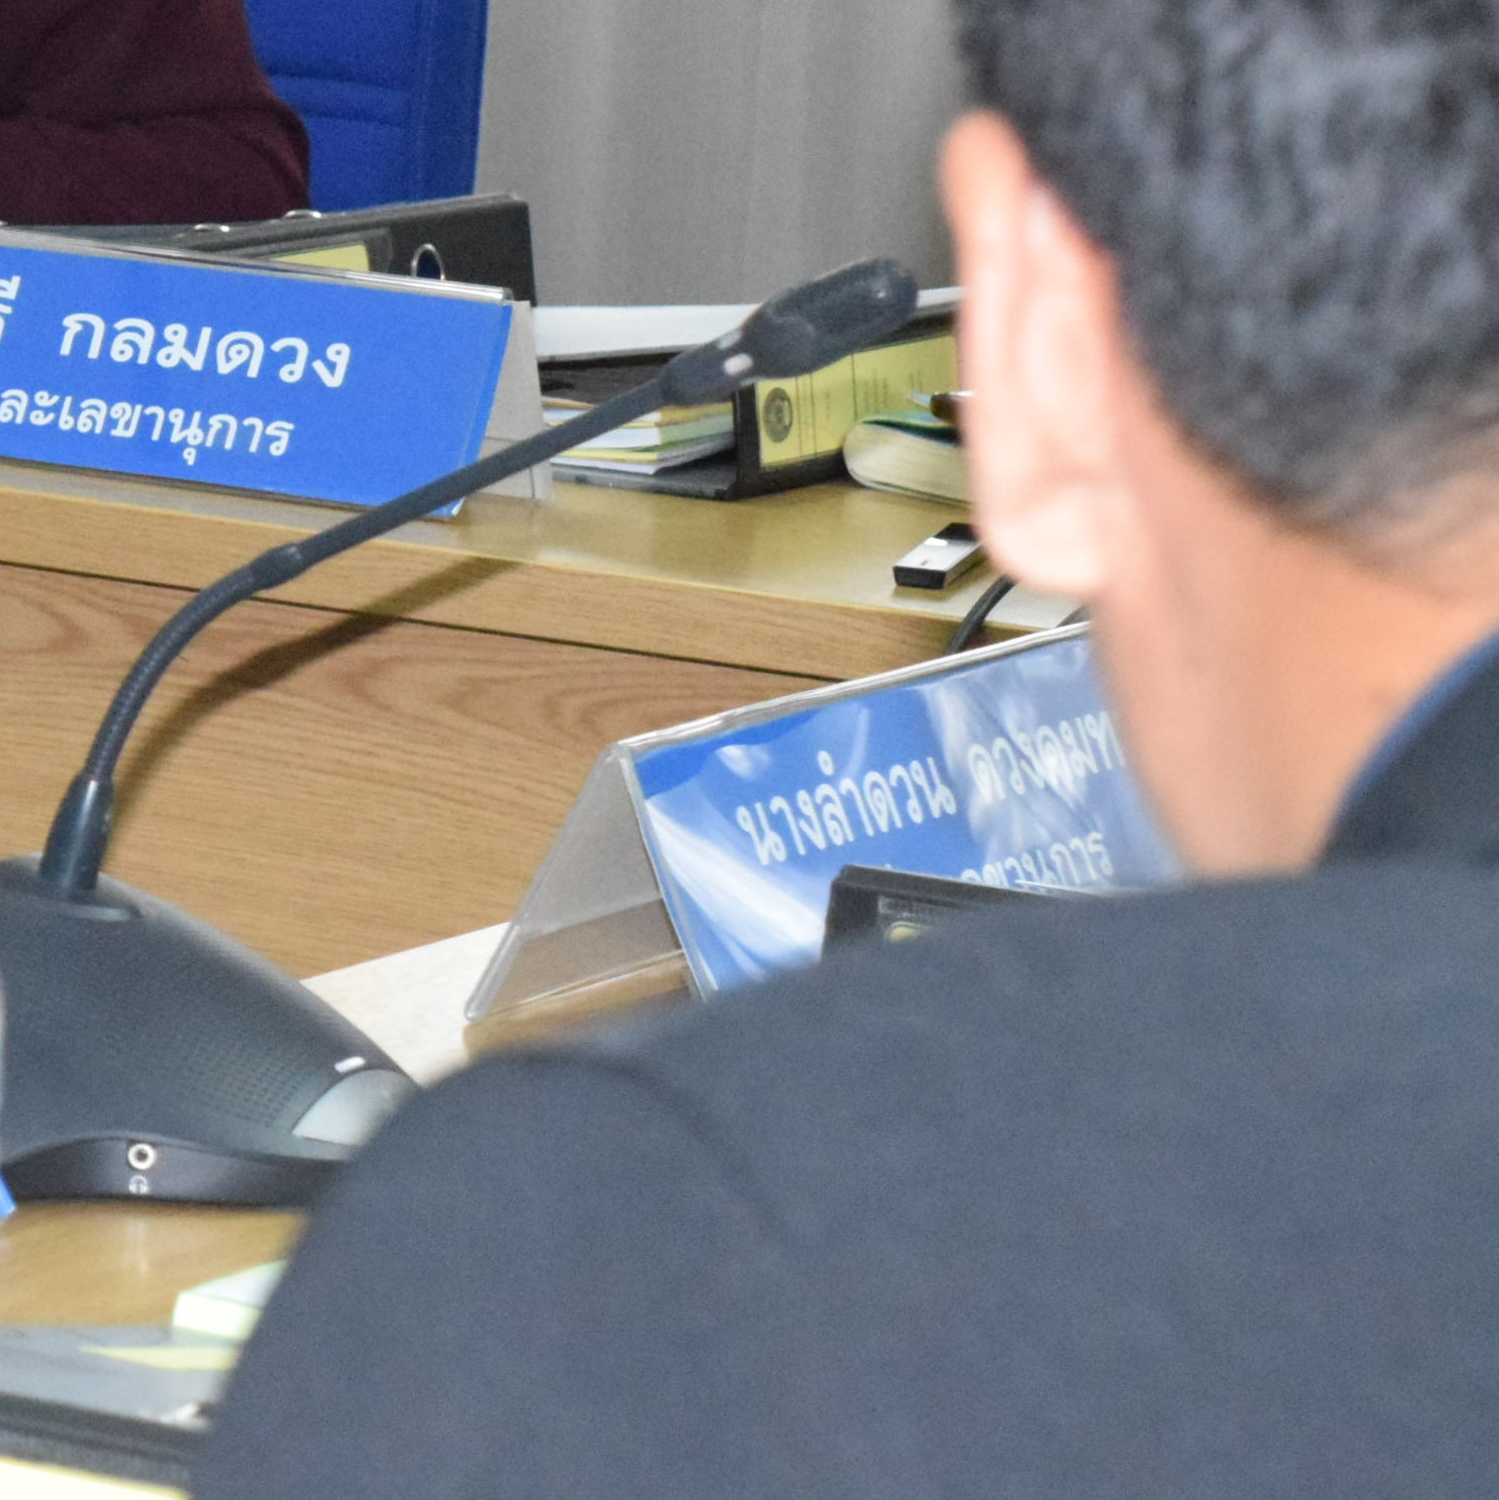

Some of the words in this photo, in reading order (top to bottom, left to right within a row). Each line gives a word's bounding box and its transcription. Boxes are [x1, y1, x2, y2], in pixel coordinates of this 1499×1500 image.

[58, 312, 352, 389] กลมดวง
[736, 750, 957, 866] นางลำดวน
